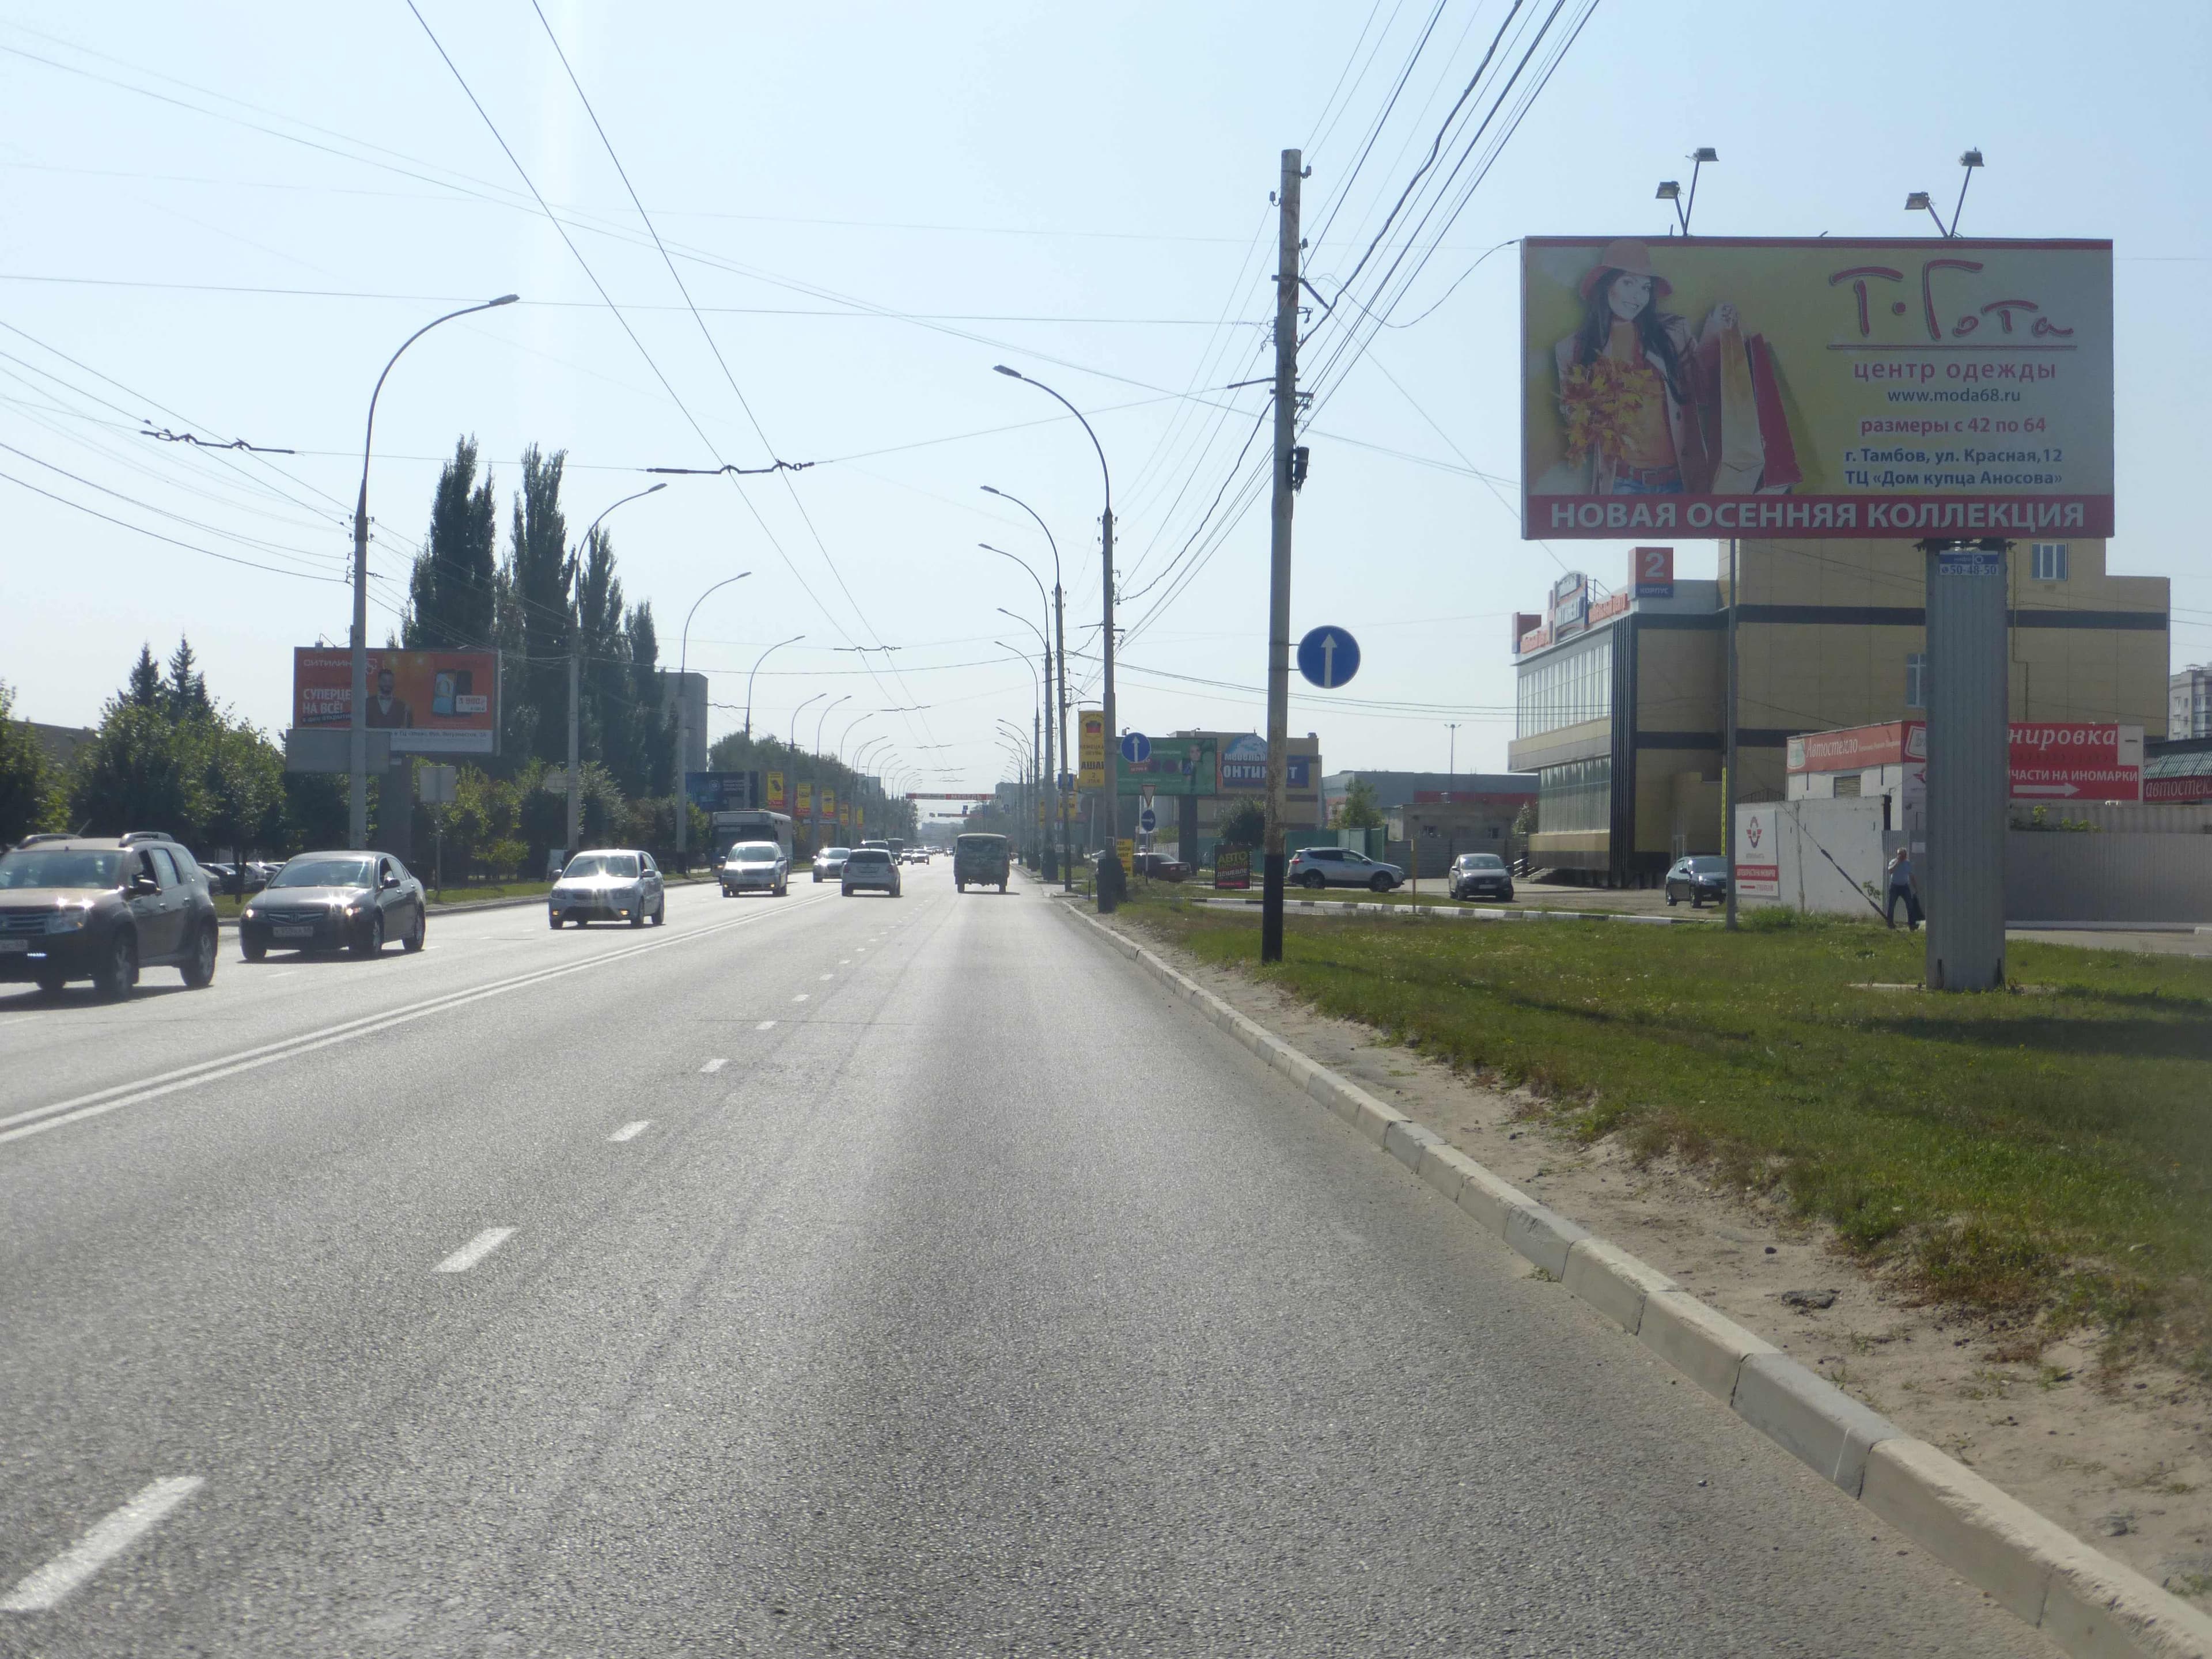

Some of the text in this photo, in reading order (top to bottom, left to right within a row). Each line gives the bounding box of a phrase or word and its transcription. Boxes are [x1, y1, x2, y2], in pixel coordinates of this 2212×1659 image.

[1854, 362, 2055, 383] центр одежды
[1888, 388, 2021, 403] www.moda68.ru
[1861, 417, 2046, 436] размеры с 42 по 64
[1845, 452, 1857, 462] г.
[1861, 448, 1930, 464] Тамбов,
[1935, 452, 1960, 465] ул.
[1845, 471, 2062, 487] ТЦ «Дом купца Аносова»
[1551, 502, 2085, 533] НОВАЯ ОСЕННЯЯ КОЛЛЕКЦИЯ
[1645, 552, 1664, 577] 2
[1950, 565, 1997, 575] 50-48-50
[304, 659, 352, 667] СИТИЛИН
[303, 688, 353, 701] СУПЕРЦЕ
[302, 703, 317, 714] НА
[2009, 728, 2116, 751] нировка
[1806, 738, 1858, 758] Автостекло
[2052, 770, 2068, 781] НА
[2071, 771, 2138, 782] ИНОМАРКИ
